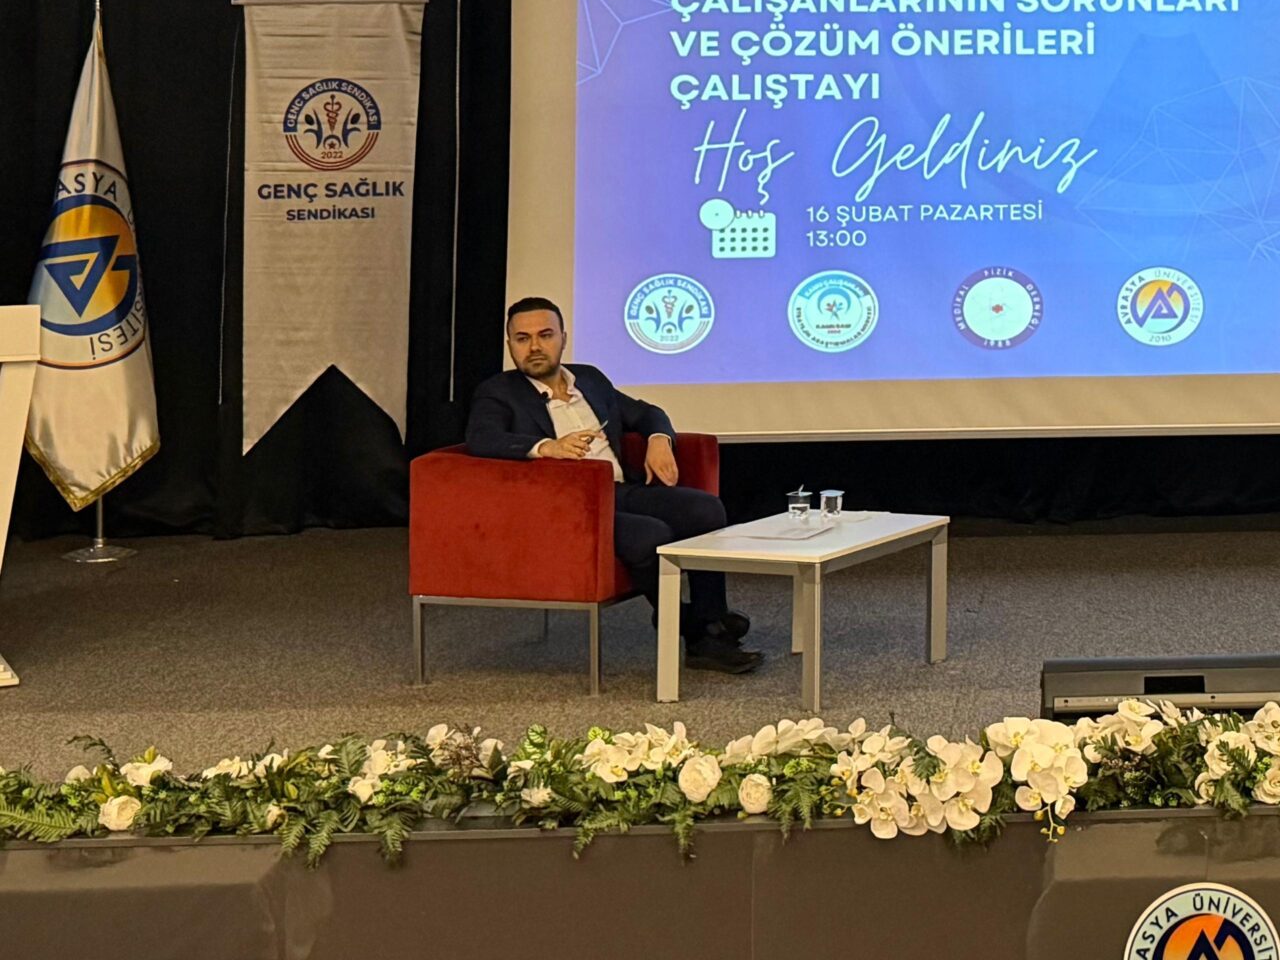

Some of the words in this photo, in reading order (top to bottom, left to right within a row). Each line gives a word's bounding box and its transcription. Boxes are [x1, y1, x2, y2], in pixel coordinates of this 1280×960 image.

[670, 30, 719, 56] VE
[731, 21, 879, 65] ÇÖZÜM
[891, 20, 1095, 56] ÖNERİLERİ
[301, 82, 339, 100] SAĞLIK
[340, 82, 378, 125] SENDİKASI
[670, 72, 881, 109] ÇALIŞTAYI
[321, 151, 343, 159] 2022
[694, 108, 795, 205] Hoş
[831, 111, 1098, 202] Geldiniz
[257, 183, 318, 203] GENÇ
[324, 178, 405, 199] SAĞLIK
[286, 205, 375, 221] SENDİKASI
[806, 206, 830, 222] 16
[836, 205, 913, 228] ŞUBAT
[920, 199, 1044, 221] PAZARTESİ
[806, 230, 867, 247] 13:00
[1120, 275, 1145, 325] AVRASYA
